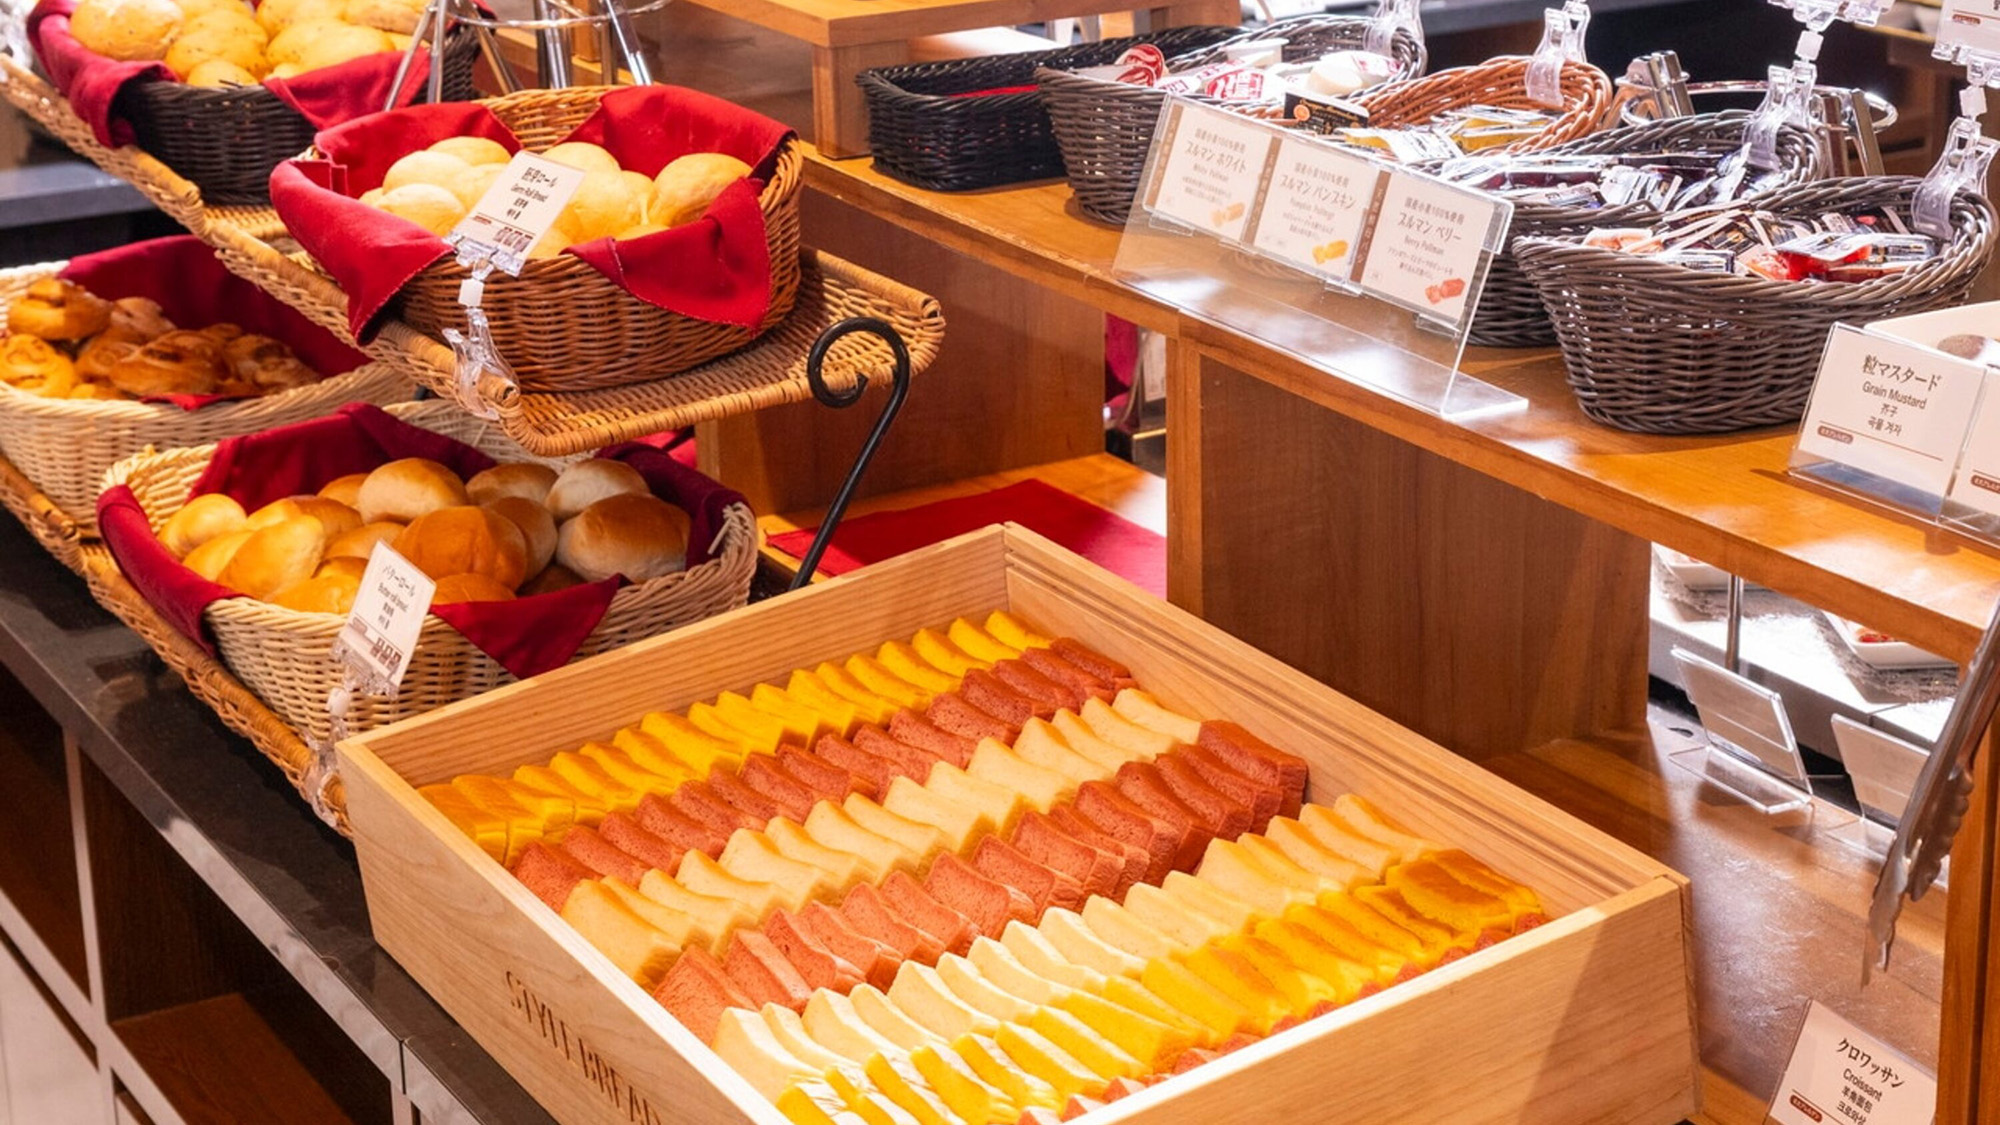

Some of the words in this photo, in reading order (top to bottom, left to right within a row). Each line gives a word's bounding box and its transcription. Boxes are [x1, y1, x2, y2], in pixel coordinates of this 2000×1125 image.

[1862, 354, 1943, 392] 粒マスタード
[1862, 381, 1887, 398] Grain
[1888, 389, 1927, 409] Mustard
[1836, 1038, 1905, 1088] クロワッサン
[1843, 1068, 1883, 1102] Croissant
